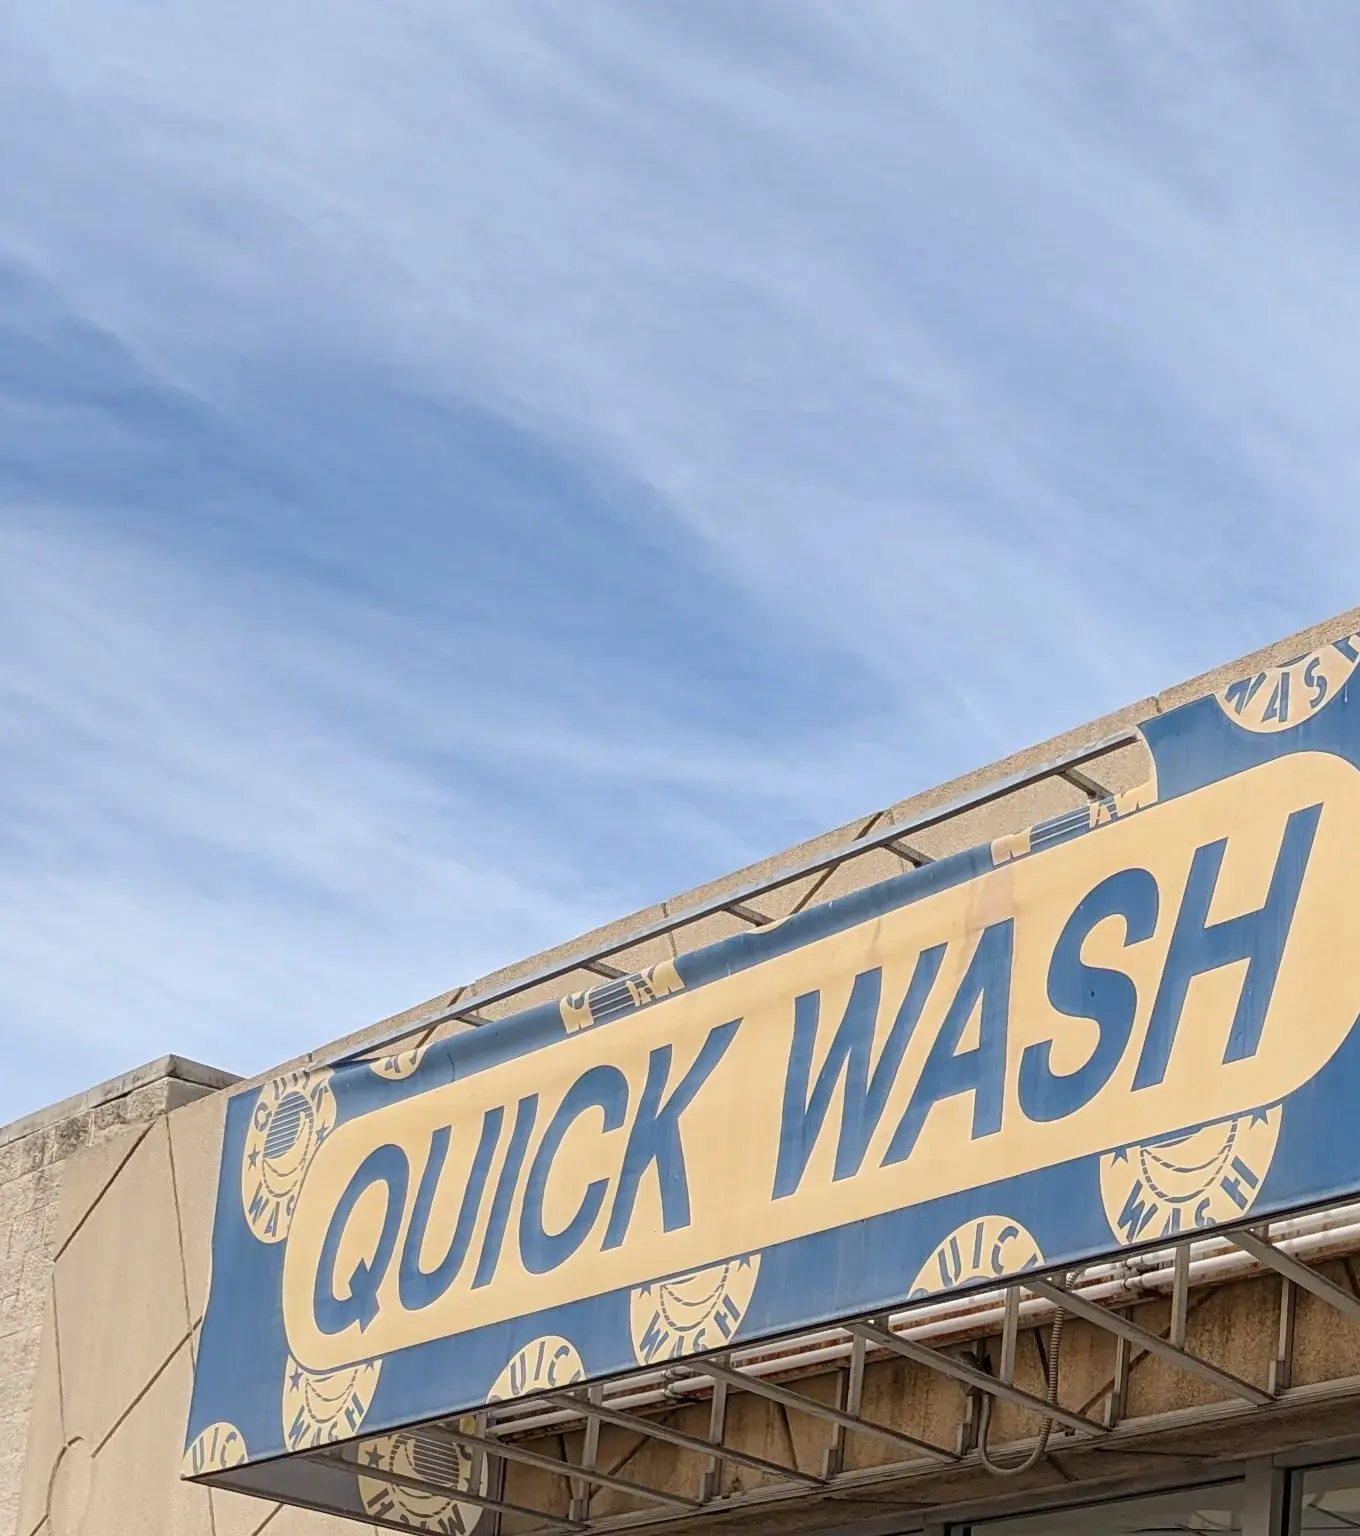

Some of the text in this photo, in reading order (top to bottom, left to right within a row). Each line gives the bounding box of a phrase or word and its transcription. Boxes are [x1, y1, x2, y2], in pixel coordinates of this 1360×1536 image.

[313, 802, 1324, 1334] QUICK WASH
[912, 1222, 1039, 1292] UIC
[491, 1341, 581, 1400] UIC
[181, 1426, 246, 1476] UIC
